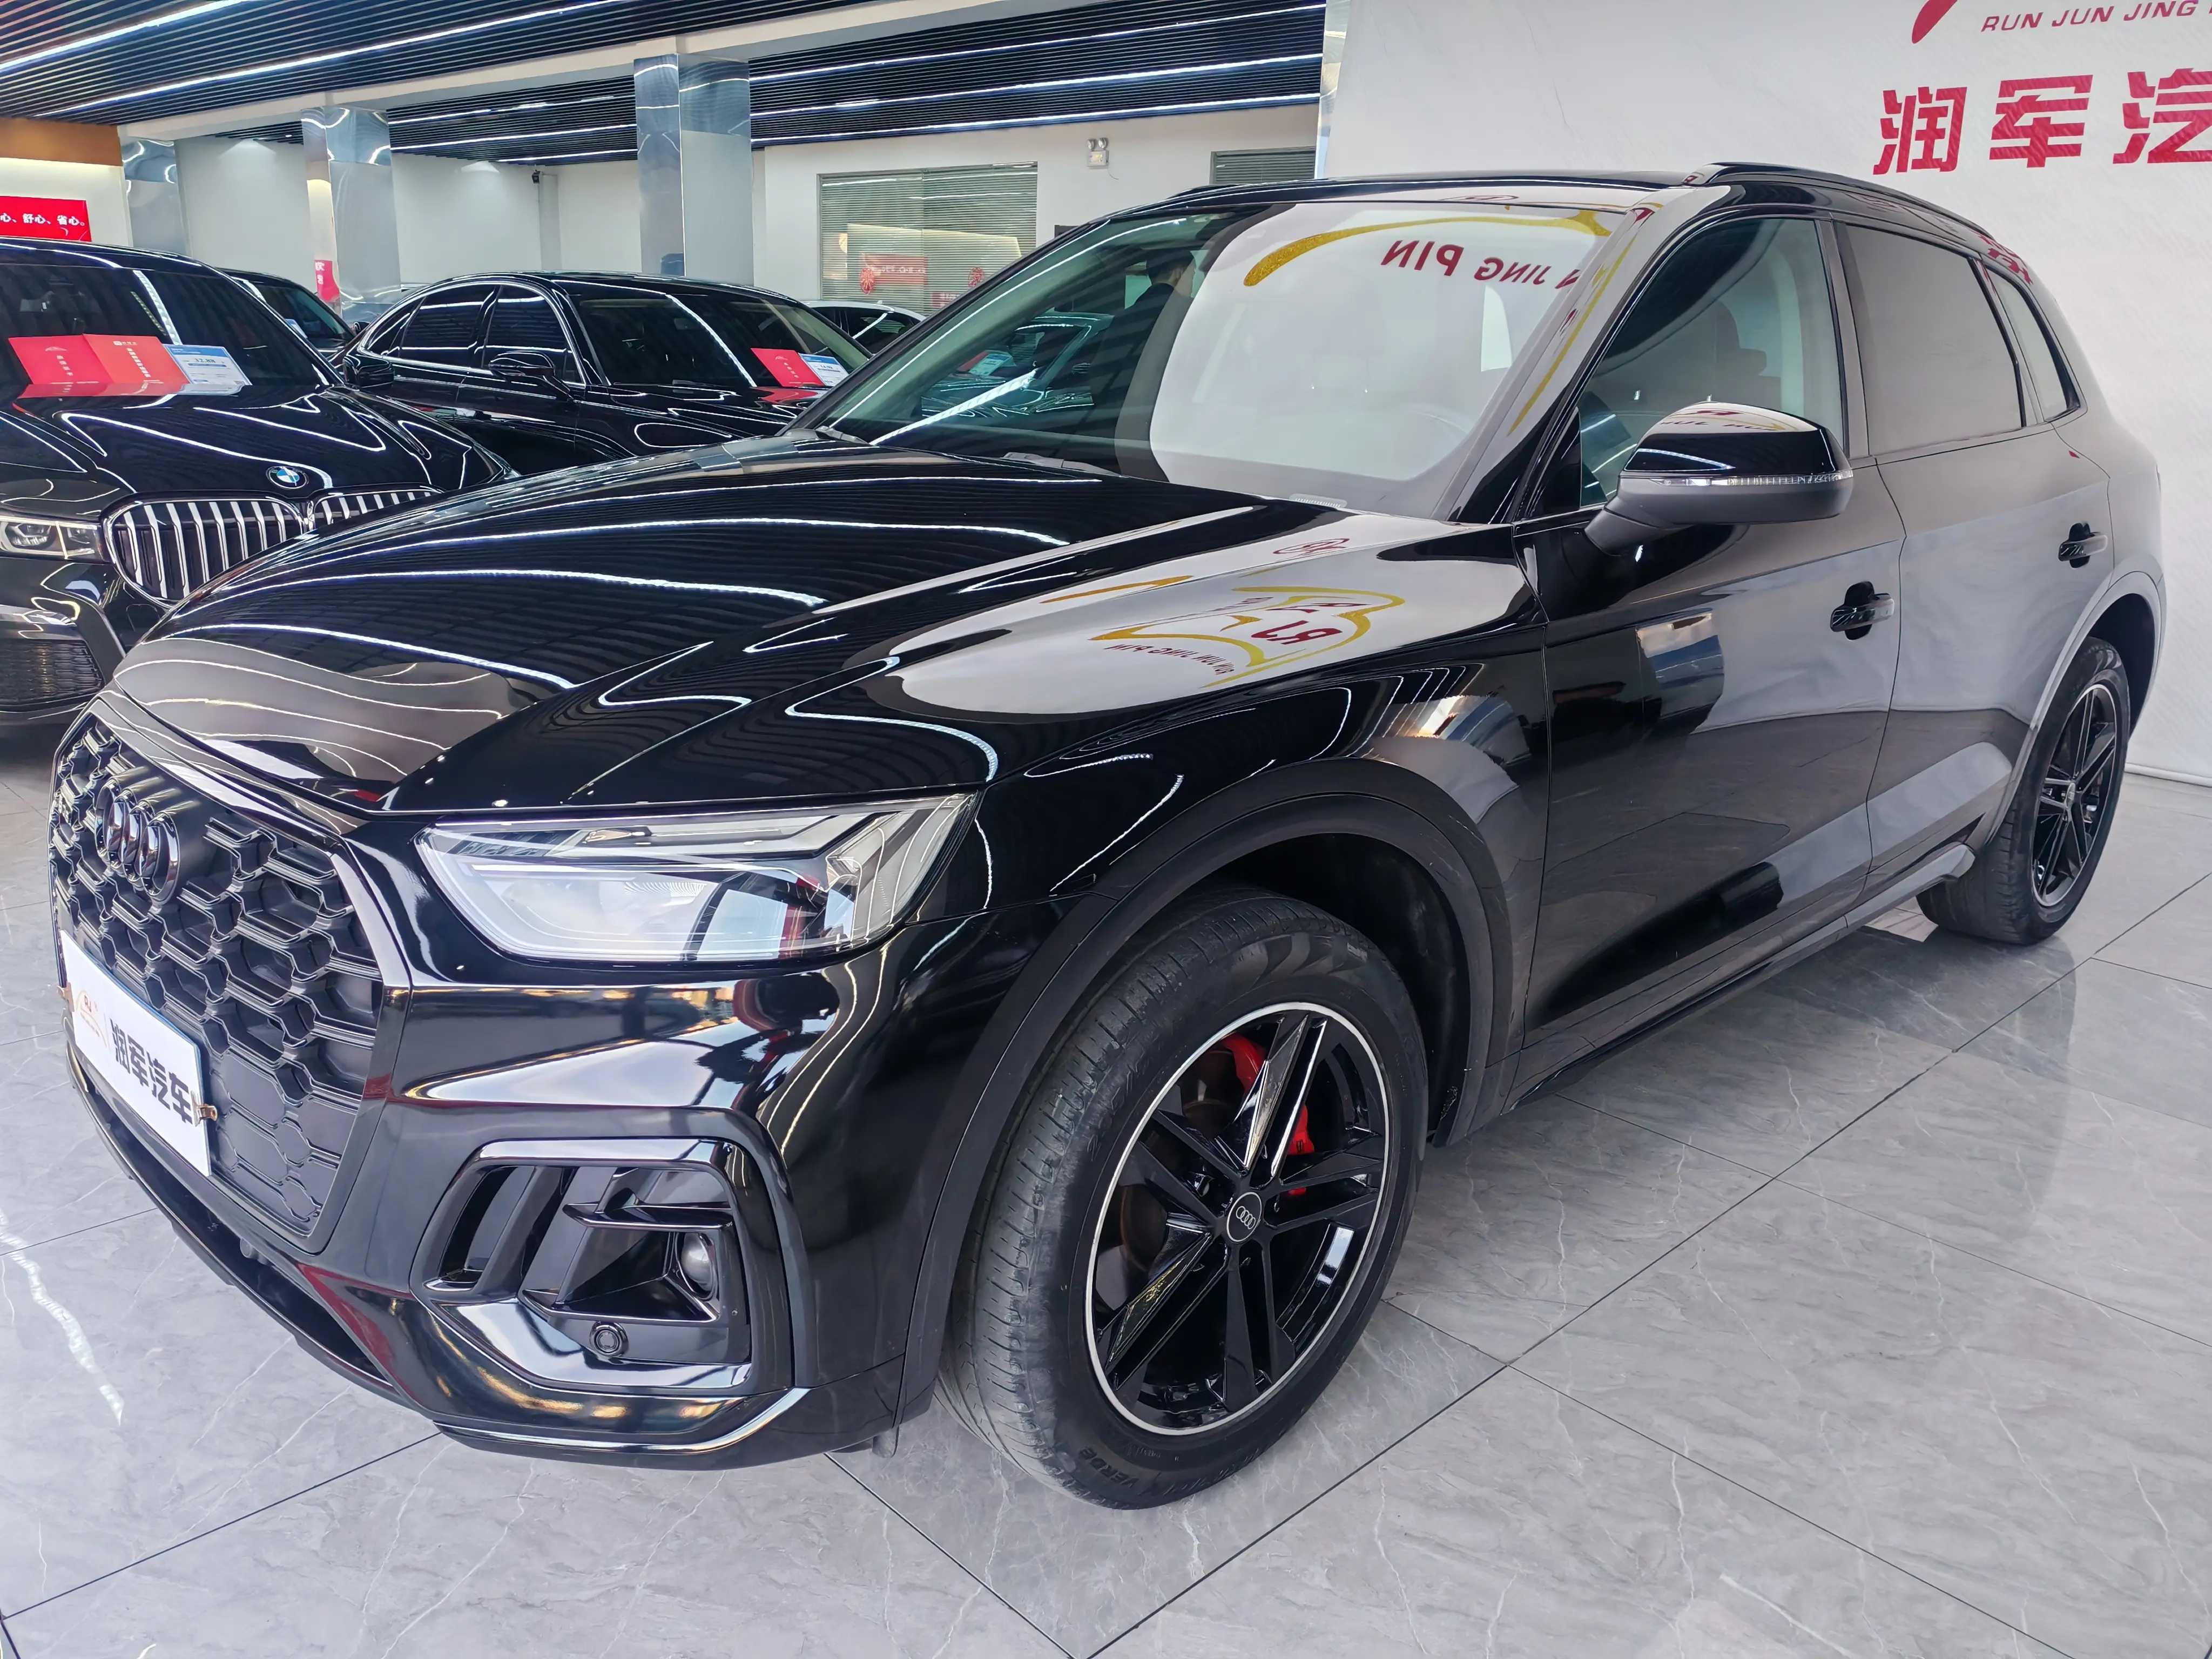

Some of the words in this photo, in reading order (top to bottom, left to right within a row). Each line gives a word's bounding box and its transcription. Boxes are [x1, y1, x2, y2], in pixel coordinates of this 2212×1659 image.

[1981, 12, 2044, 32] RUN
[2052, 6, 2114, 27] JUN
[2123, 0, 2199, 21] JING
[110, 1017, 194, 1125] 润军汽车
